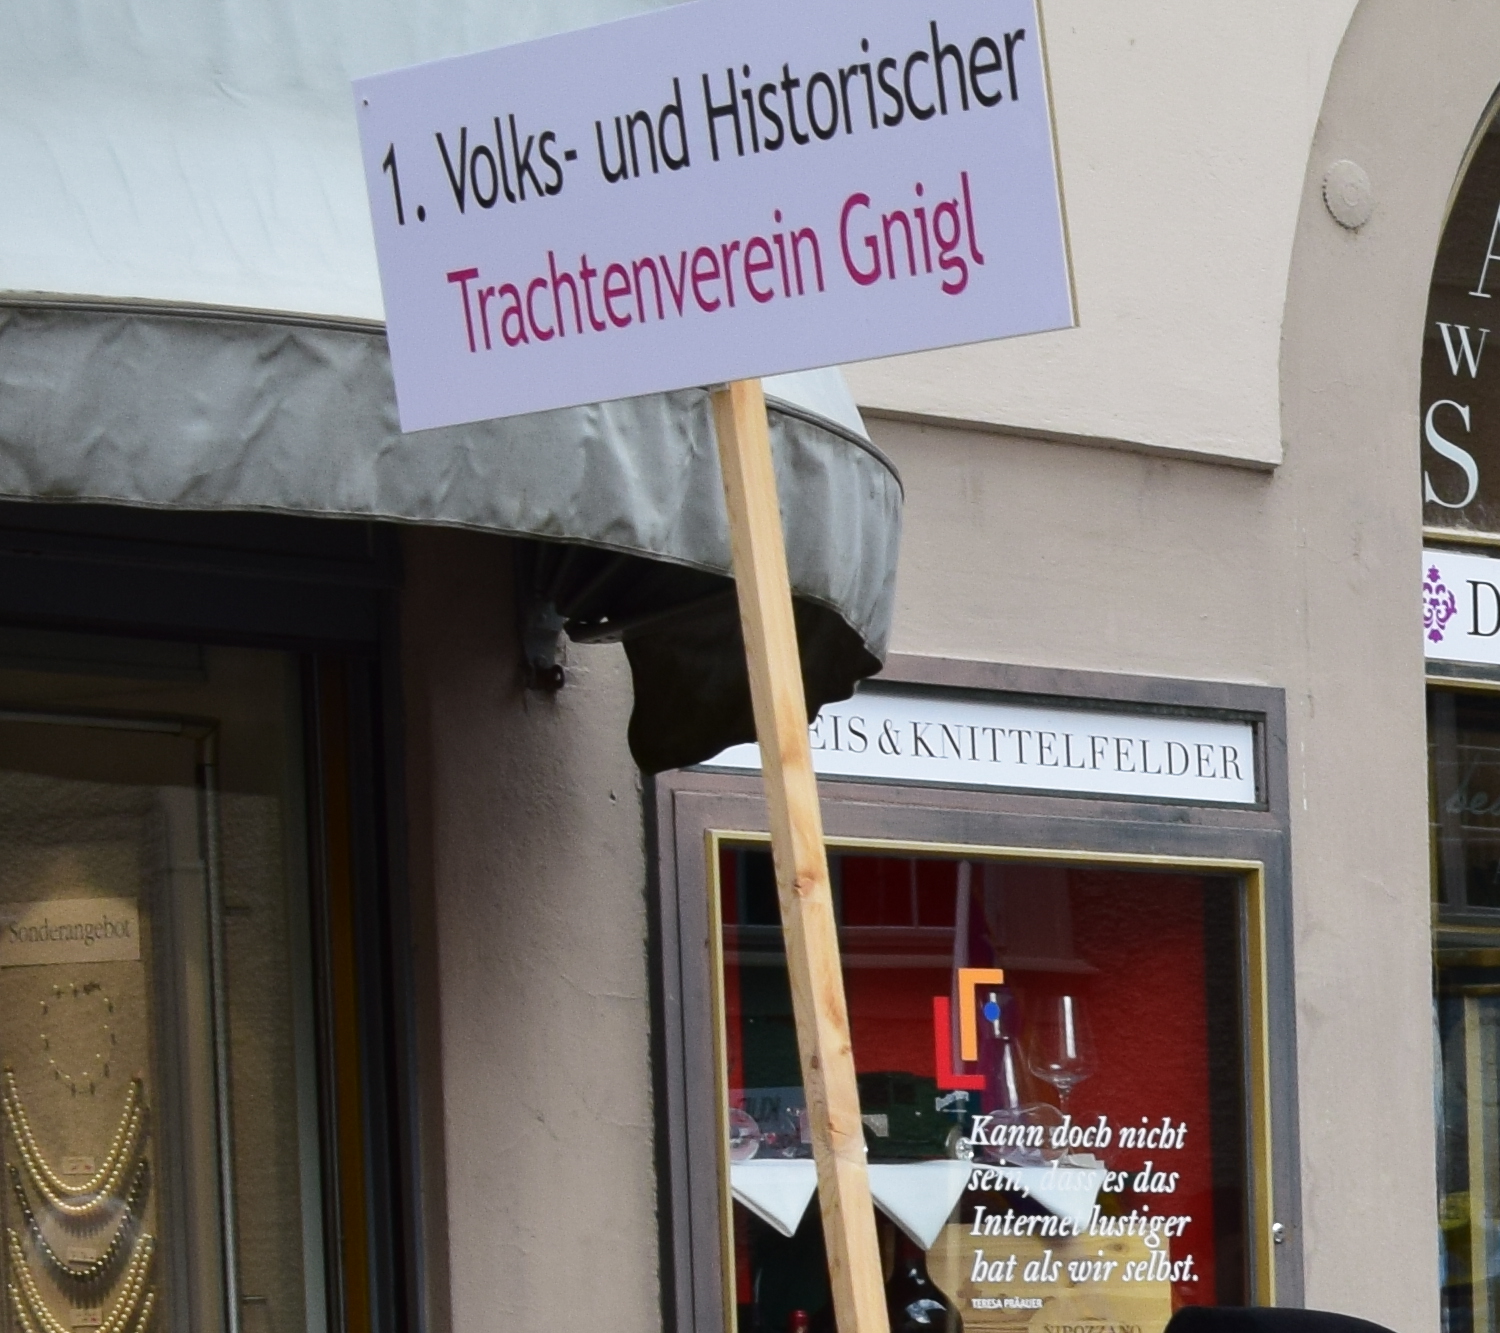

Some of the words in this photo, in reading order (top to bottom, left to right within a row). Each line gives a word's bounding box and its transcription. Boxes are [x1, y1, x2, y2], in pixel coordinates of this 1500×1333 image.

[382, 142, 427, 227] 1.
[436, 112, 579, 215] Volks-
[595, 78, 690, 182] und
[702, 21, 1026, 162] Historischer
[446, 209, 826, 353] Trachtenverein
[840, 171, 984, 296] Gnigl
[808, 713, 868, 754] EIS
[877, 718, 903, 757] &
[910, 721, 1244, 781] KNITTELFELDER
[9, 915, 132, 948] Sonderangebot
[969, 1114, 1044, 1147] Kann
[1052, 1115, 1112, 1149] doch
[1118, 1116, 1188, 1150] nicht
[968, 1160, 1030, 1198] sein,
[1102, 1169, 1128, 1193] es
[1133, 1161, 1180, 1194] das
[1088, 1204, 1192, 1248] lustiger
[971, 1250, 1017, 1283] hat
[1023, 1249, 1063, 1283] als
[1067, 1251, 1118, 1283] wir
[1122, 1250, 1200, 1283] selbst.
[971, 1298, 1002, 1310] TERESA
